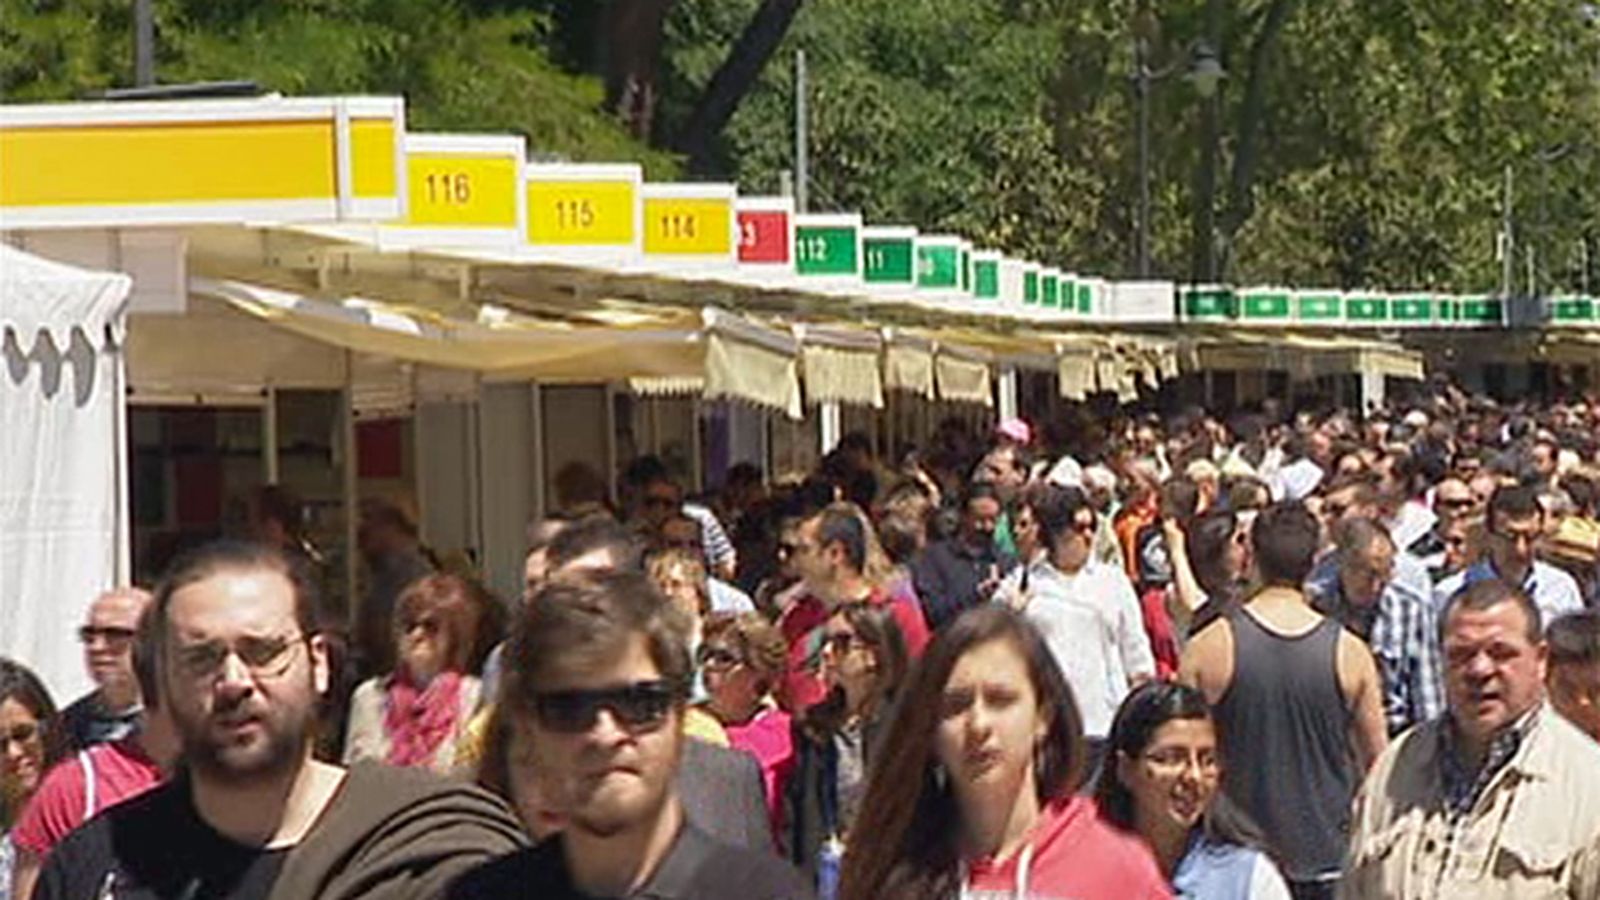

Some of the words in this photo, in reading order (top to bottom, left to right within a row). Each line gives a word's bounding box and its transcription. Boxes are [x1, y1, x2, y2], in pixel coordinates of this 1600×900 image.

[426, 174, 470, 204] 116
[556, 201, 593, 229] 115
[661, 216, 696, 239] 114
[798, 236, 826, 260] 112
